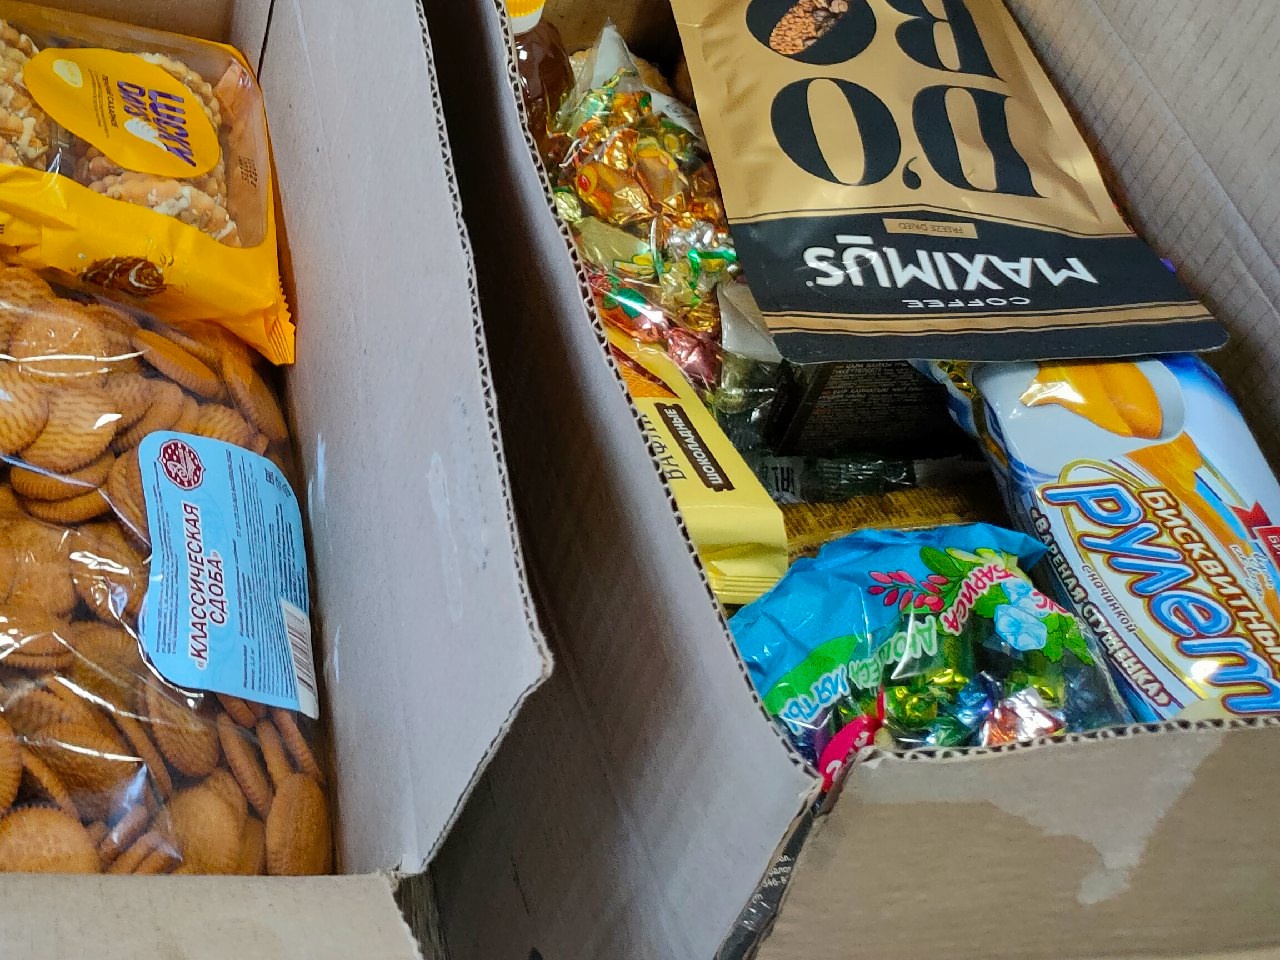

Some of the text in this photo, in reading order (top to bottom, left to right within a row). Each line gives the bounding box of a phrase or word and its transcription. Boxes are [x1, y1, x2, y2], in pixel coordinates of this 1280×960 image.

[148, 88, 197, 167] LUCKY
[802, 233, 1100, 292] MAXIMUS
[897, 221, 929, 232] DRIED
[901, 296, 1031, 309] COFFEE
[640, 412, 688, 481] ВАФ
[664, 407, 724, 485] ШОКОЛАДНЫЕ
[184, 502, 209, 671] «КЛАССИЧЕСКАЯ
[1030, 507, 1088, 605] «ВАРЕНАЯ
[1138, 487, 1280, 665] БИСКВИТНЫ
[943, 563, 1019, 634] БАРИСА
[780, 663, 849, 737] МЯТЫ
